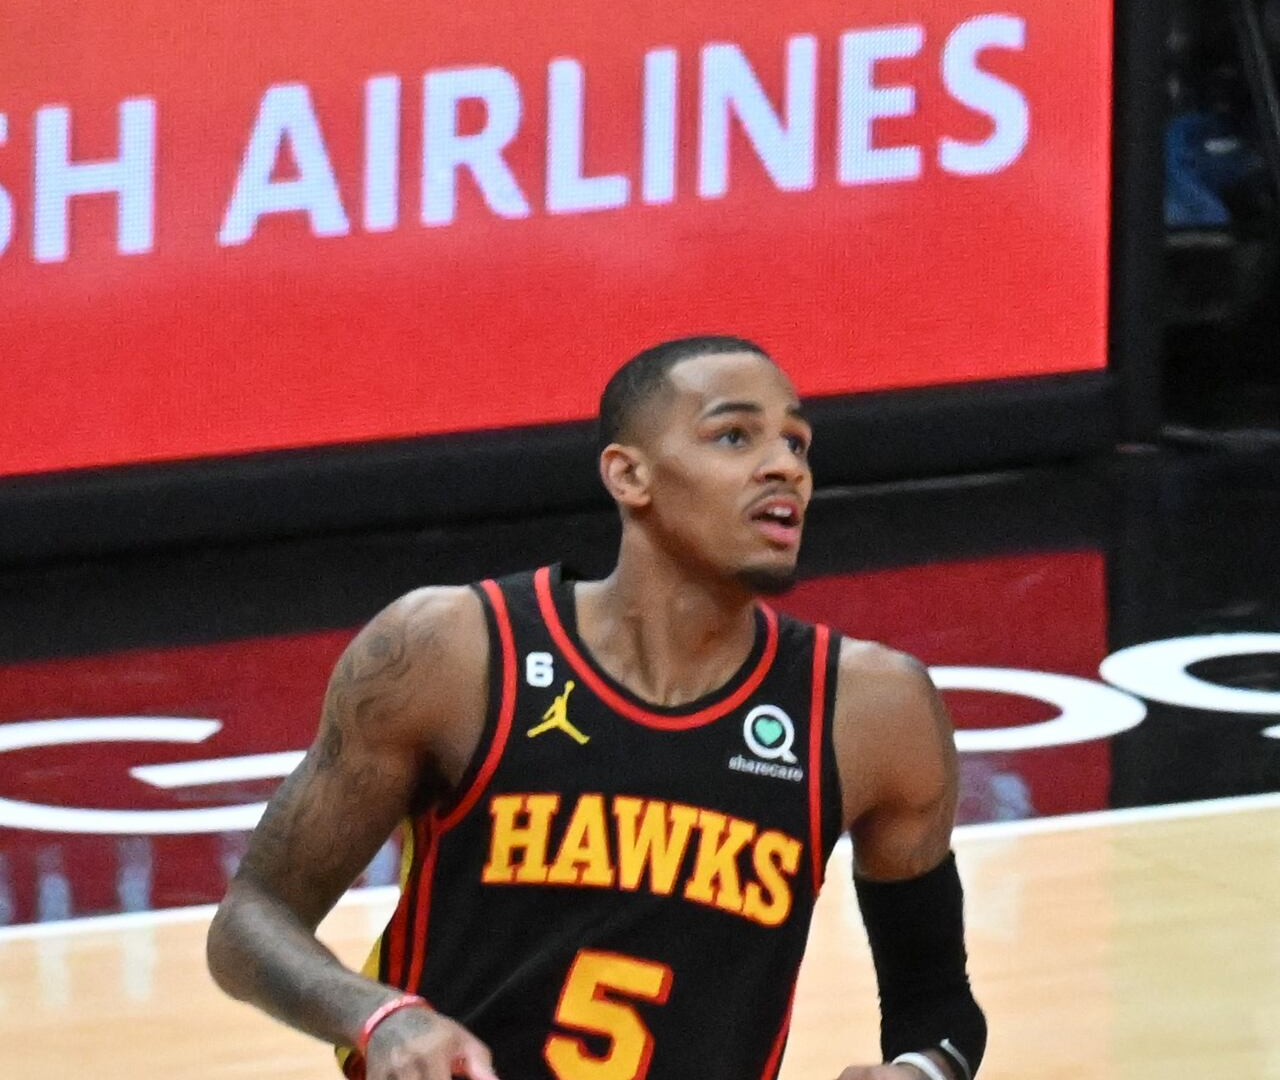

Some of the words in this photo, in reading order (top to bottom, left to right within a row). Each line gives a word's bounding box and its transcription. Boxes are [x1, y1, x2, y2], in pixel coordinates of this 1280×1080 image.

[217, 12, 1031, 247] AIRLINES
[526, 651, 554, 688] 6
[481, 792, 803, 928] HAWKS
[544, 947, 674, 1080] 5
